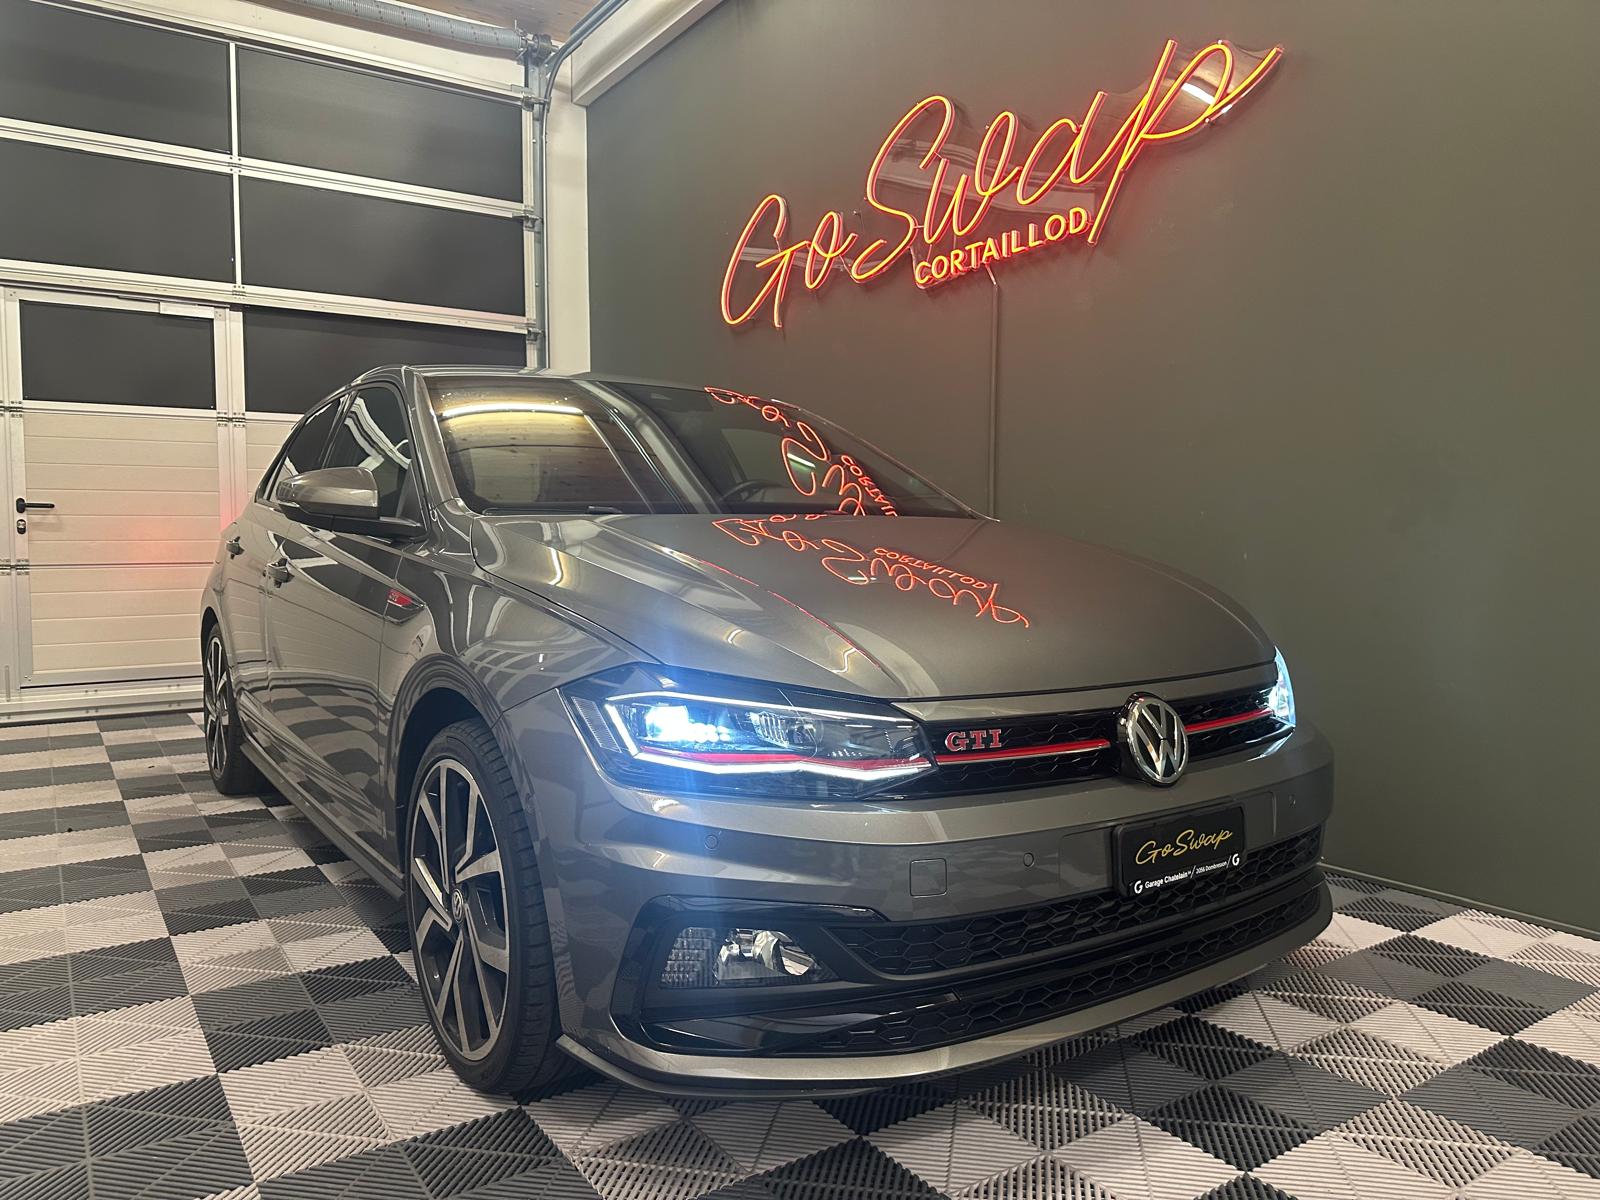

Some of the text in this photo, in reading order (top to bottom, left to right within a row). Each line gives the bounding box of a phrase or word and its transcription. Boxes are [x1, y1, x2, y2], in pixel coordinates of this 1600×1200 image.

[914, 207, 1090, 284] CORTAILLOD
[944, 728, 1002, 751] GTI
[1144, 878, 1164, 889] Garage
